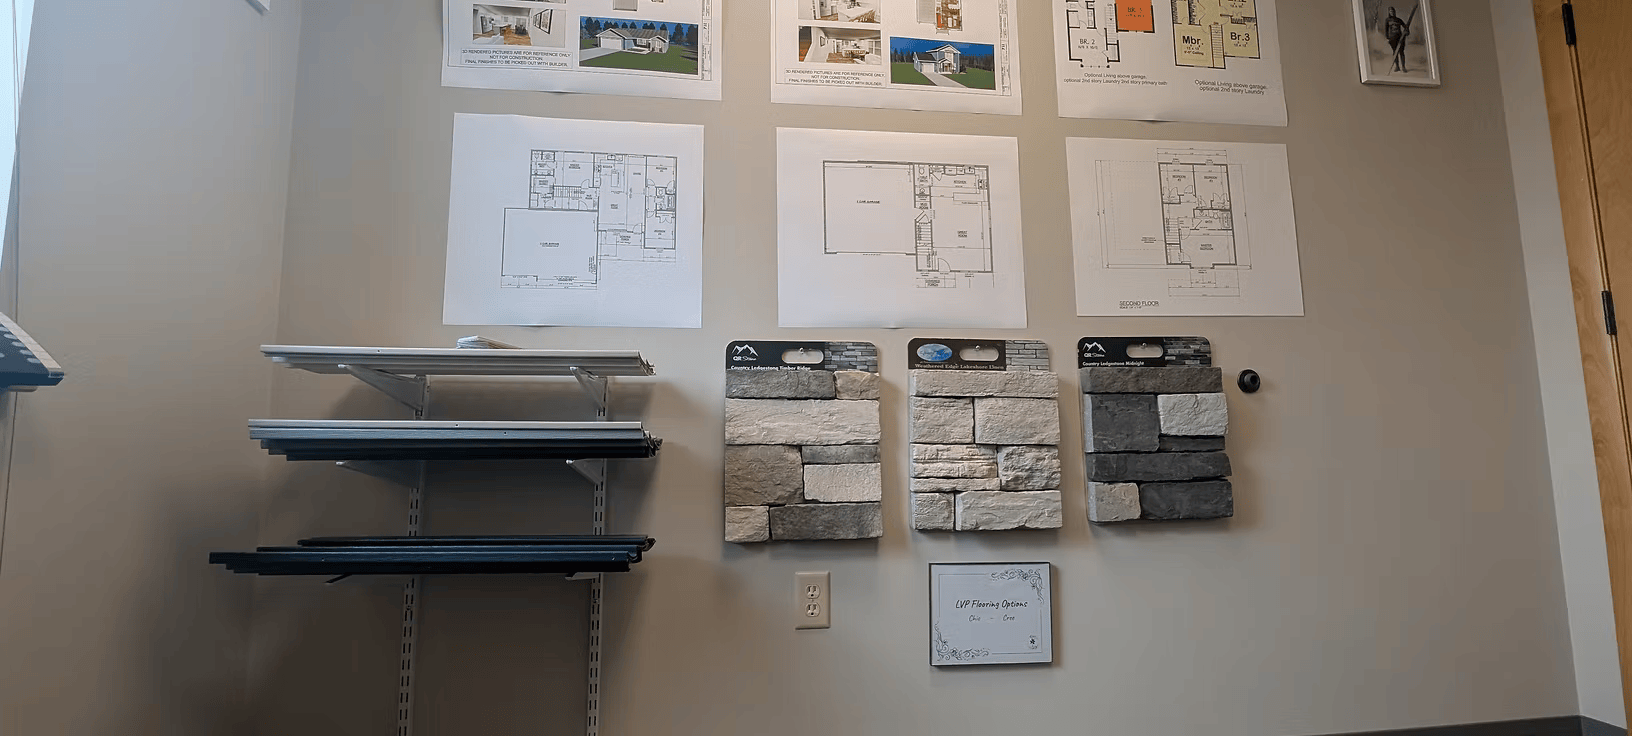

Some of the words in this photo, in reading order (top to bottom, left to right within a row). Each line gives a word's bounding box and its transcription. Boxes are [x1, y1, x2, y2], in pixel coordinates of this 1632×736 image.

[1182, 36, 1204, 45] Mbr.
[1230, 32, 1250, 42] Br.3
[955, 599, 970, 609] LVP
[971, 599, 1000, 610] Flooring
[1001, 599, 1028, 610] Options
